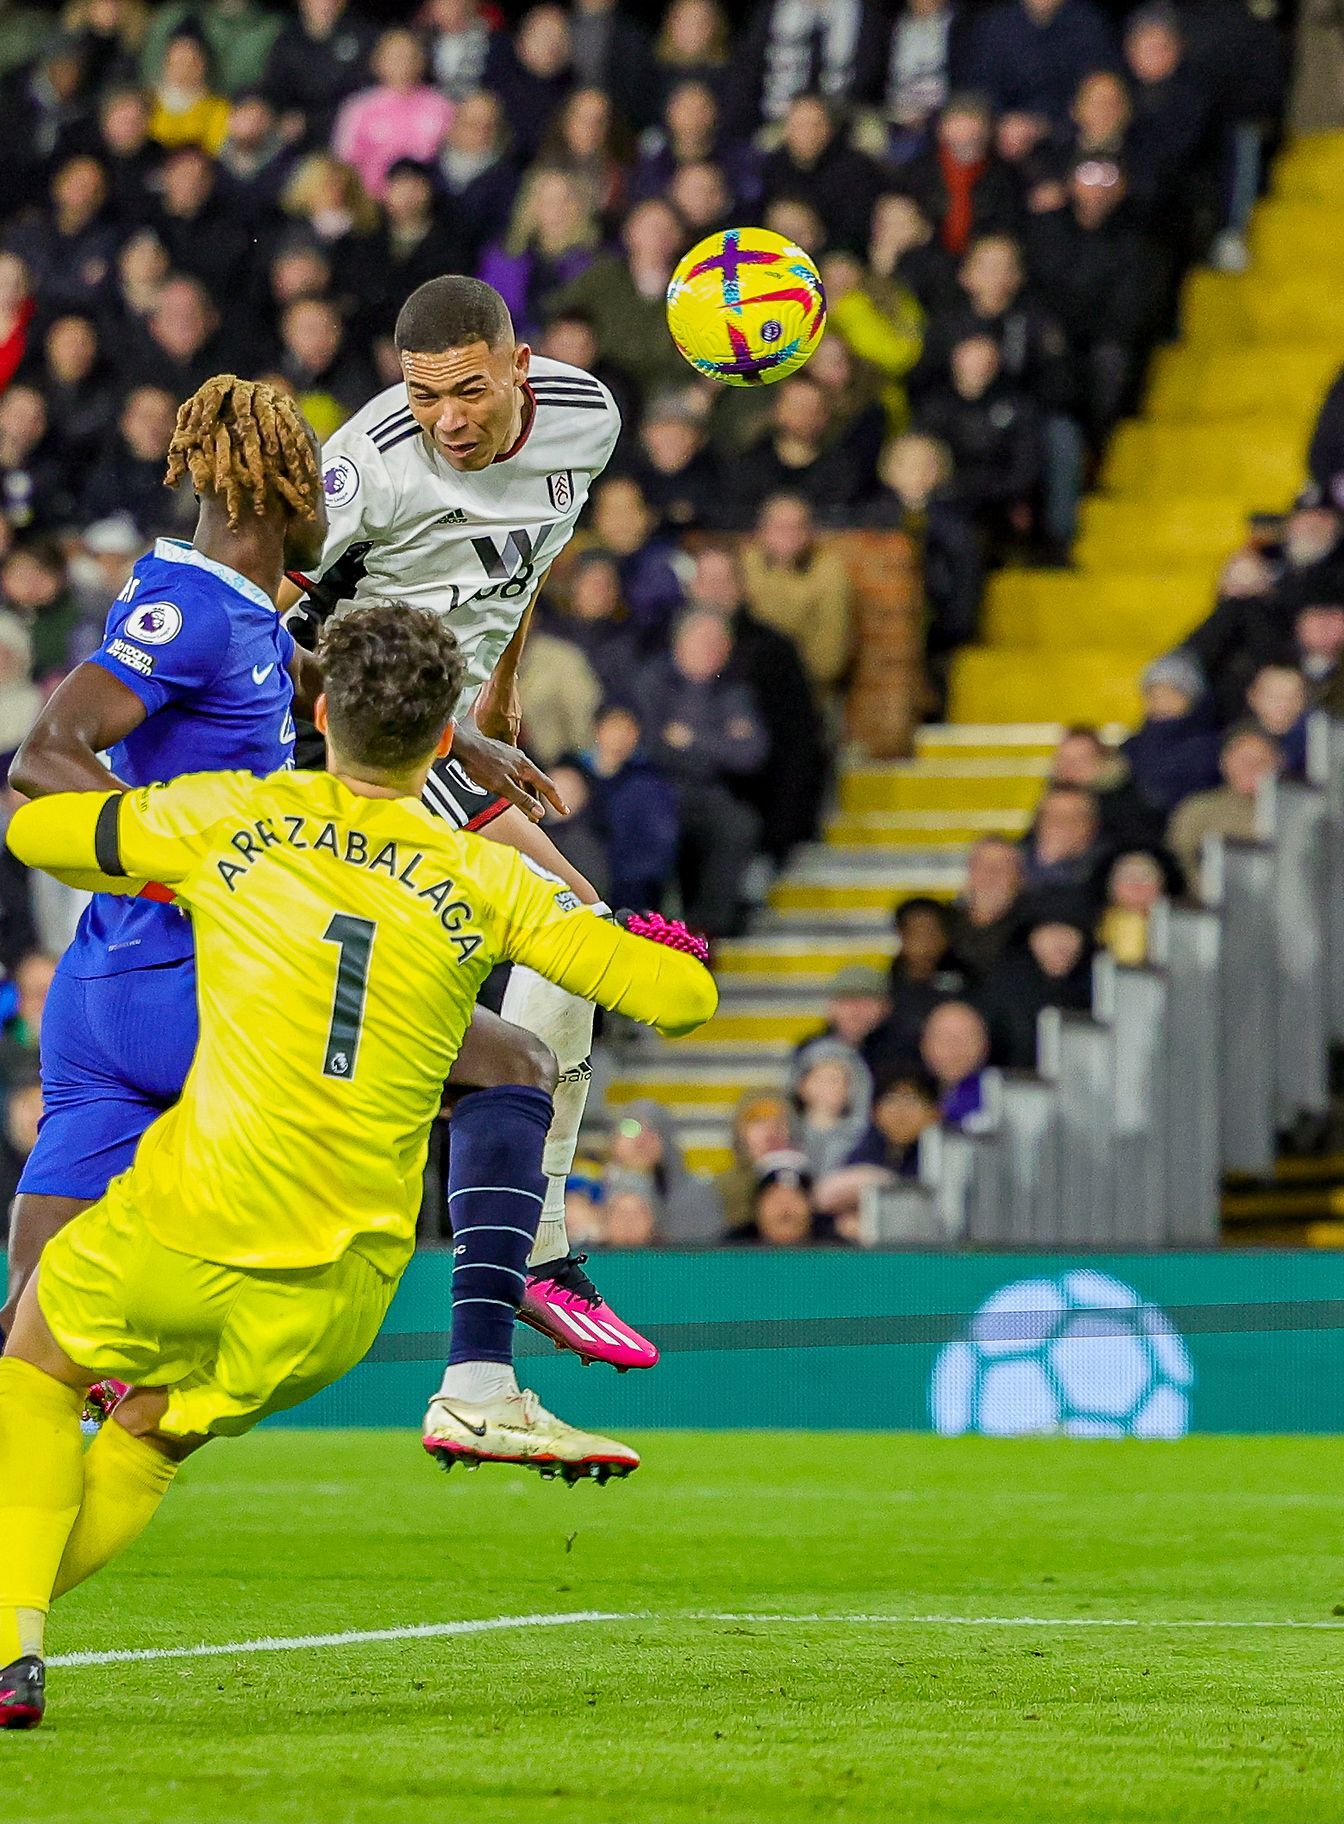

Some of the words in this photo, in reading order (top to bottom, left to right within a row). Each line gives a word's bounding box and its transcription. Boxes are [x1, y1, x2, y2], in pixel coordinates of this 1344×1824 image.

[123, 643, 153, 667] room
[216, 816, 484, 966] ARRZABALAGA
[322, 912, 378, 1081] 1
